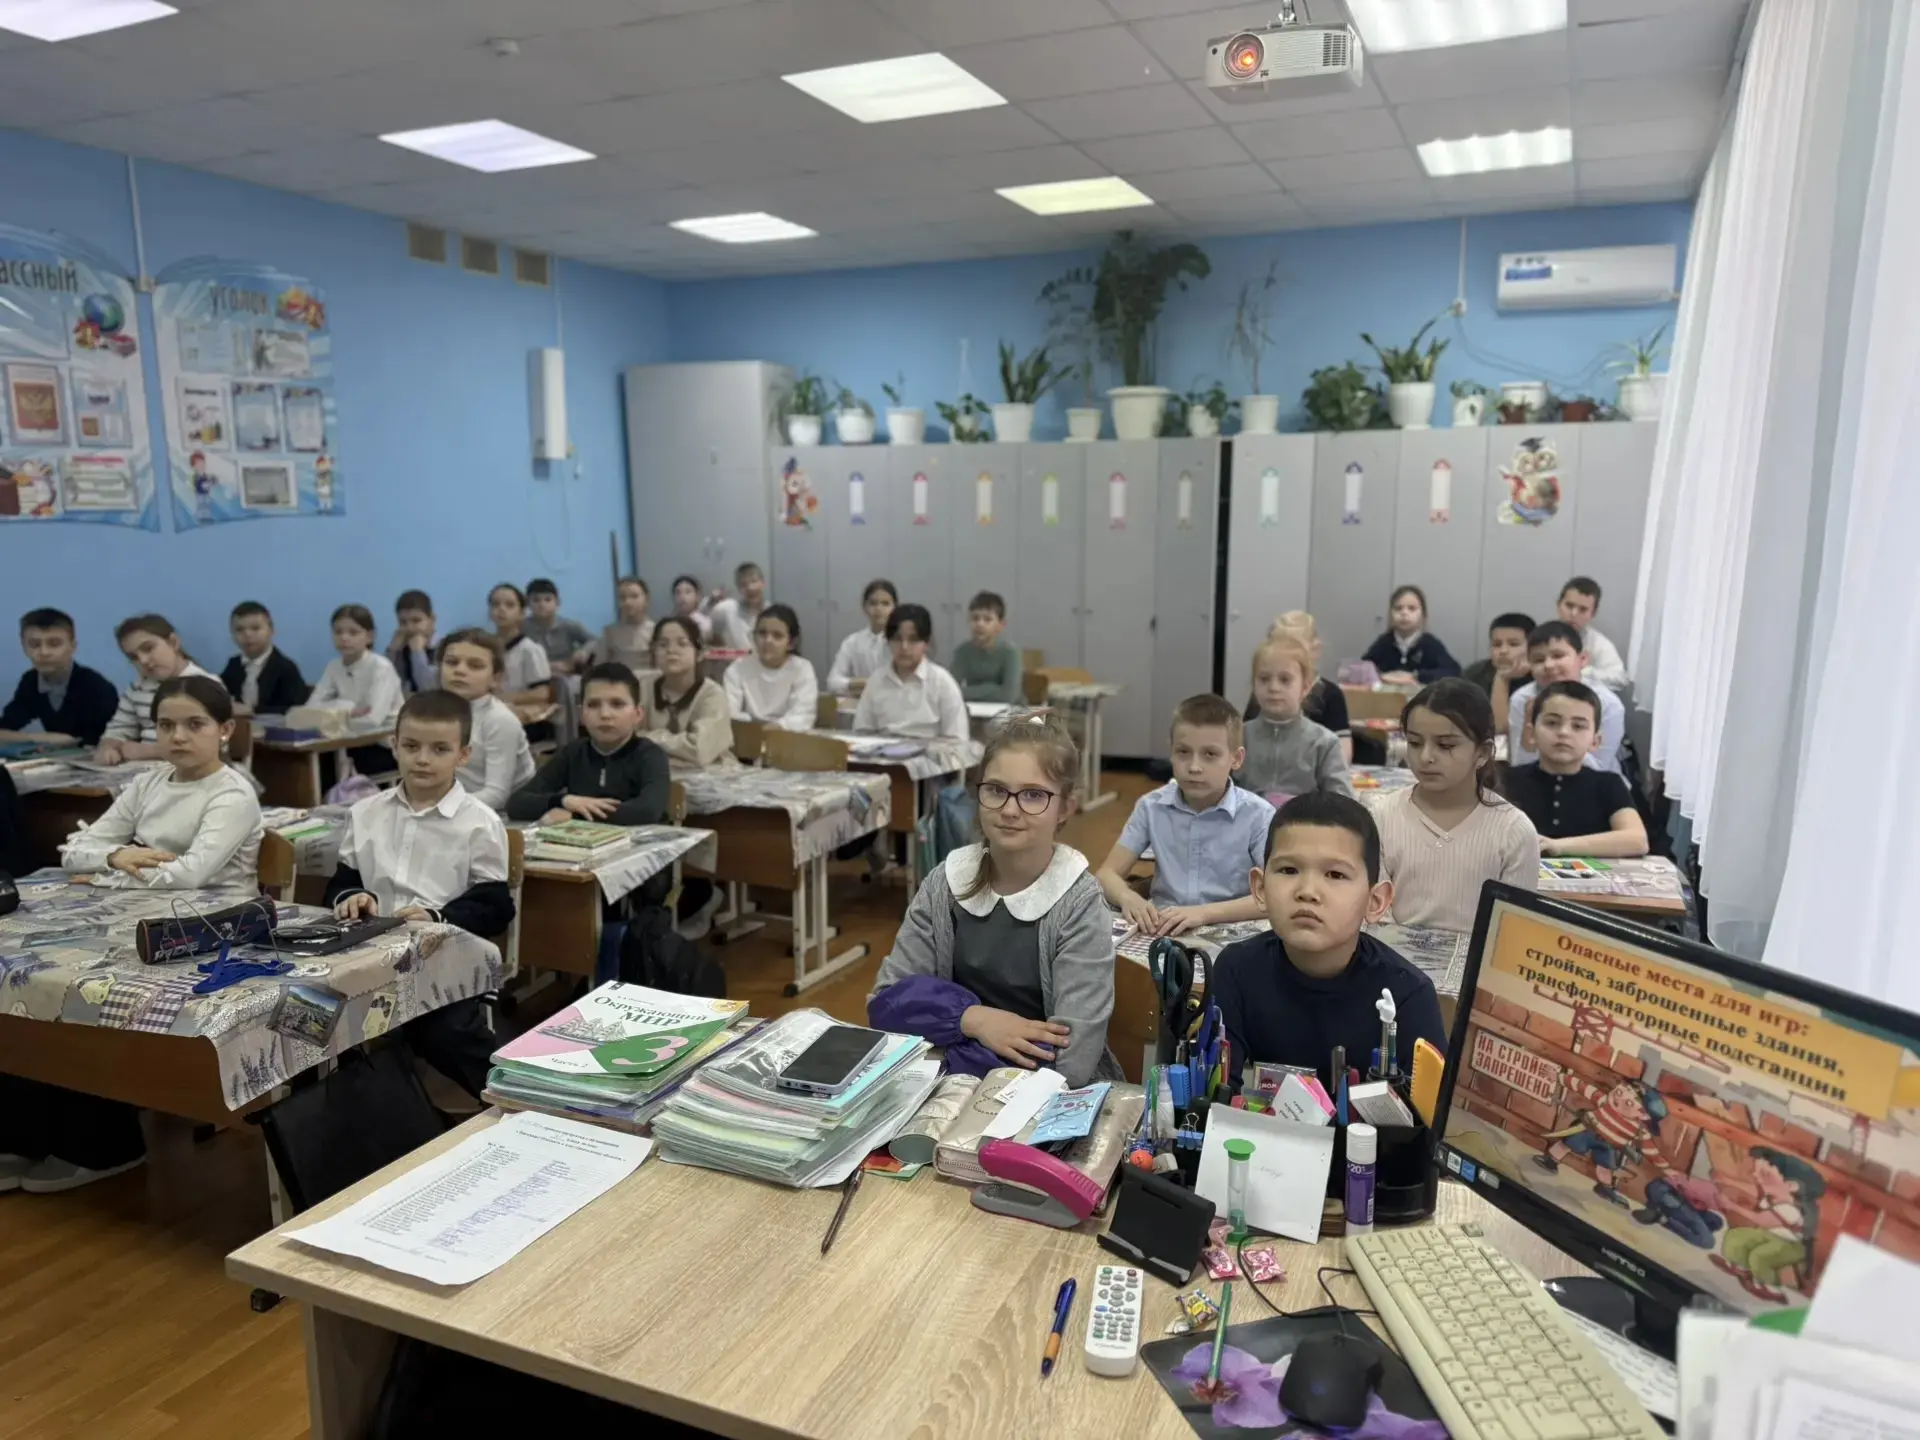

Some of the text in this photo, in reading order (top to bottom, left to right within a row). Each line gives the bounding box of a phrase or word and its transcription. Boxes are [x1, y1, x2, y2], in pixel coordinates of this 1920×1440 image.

[1517, 963, 1848, 1102] трансформаторные подстанции
[1525, 947, 1845, 1077] стройка, заброшенные здания,
[1557, 934, 1811, 1037] Опасные места для игр:
[611, 1035, 689, 1066] 3
[1477, 1035, 1549, 1077] НА СТРОЙ
